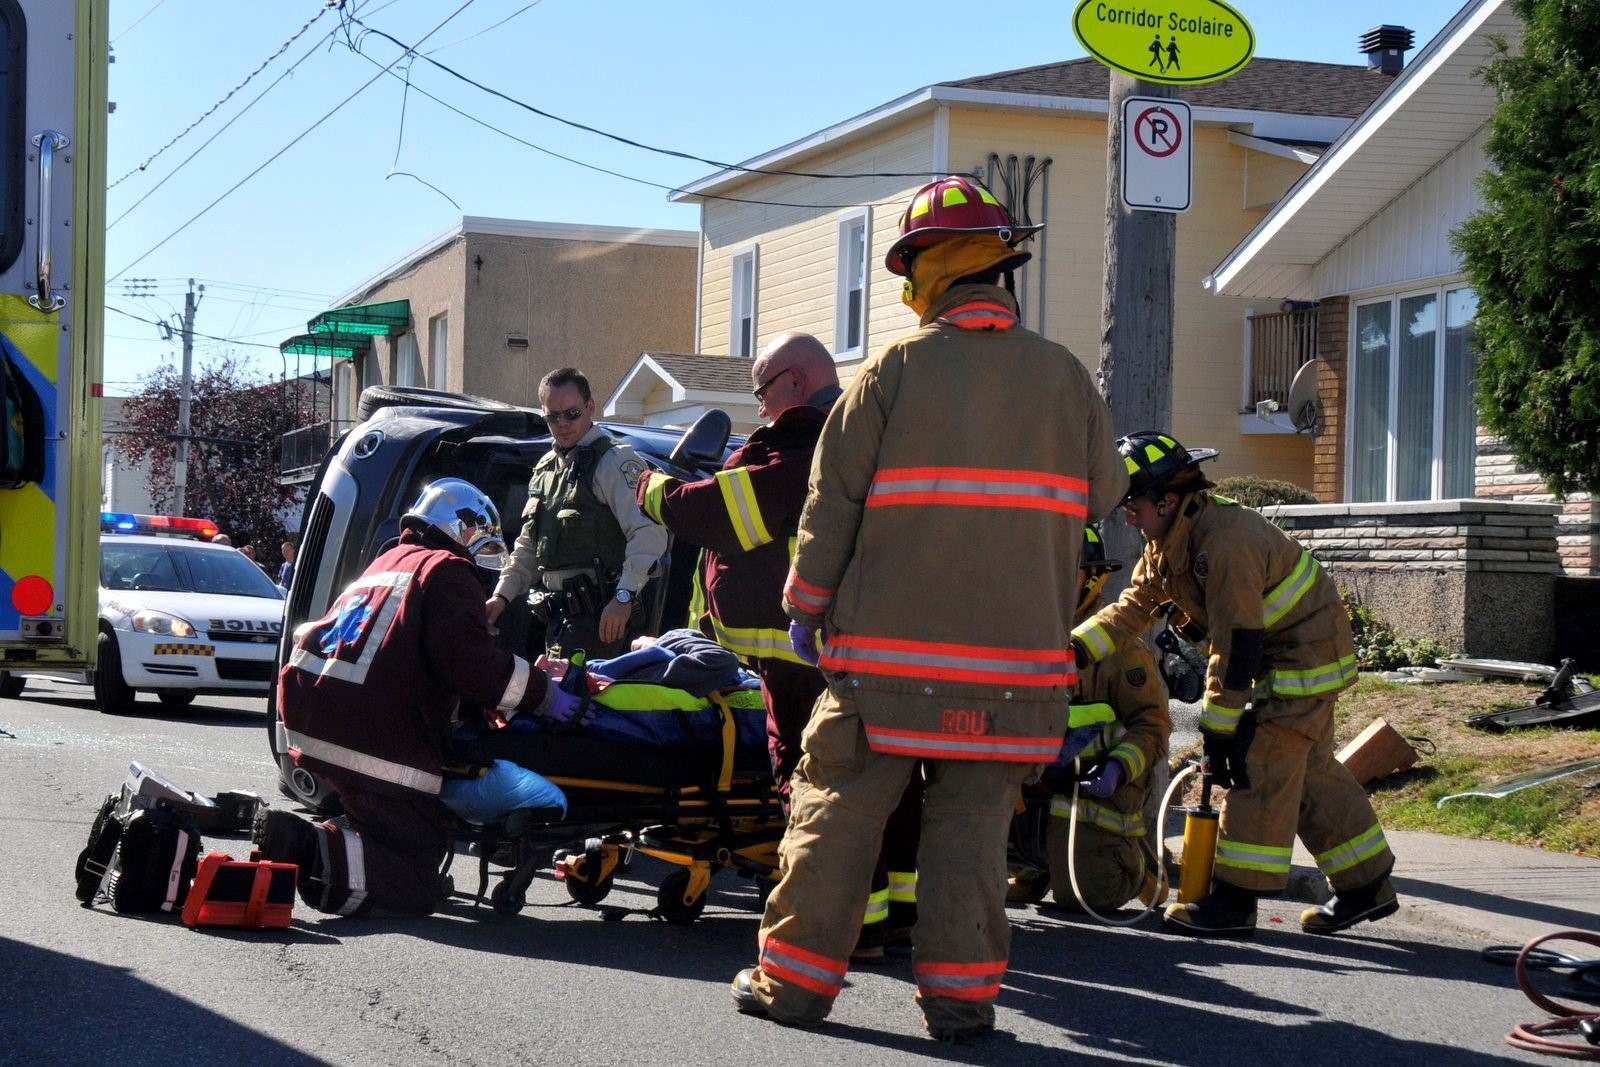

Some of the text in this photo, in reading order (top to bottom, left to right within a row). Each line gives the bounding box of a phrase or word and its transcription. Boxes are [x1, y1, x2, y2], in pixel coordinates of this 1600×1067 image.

[1097, 3, 1233, 37] Corridor Scolaire
[1151, 118, 1168, 144] P
[107, 600, 136, 617] POLICE
